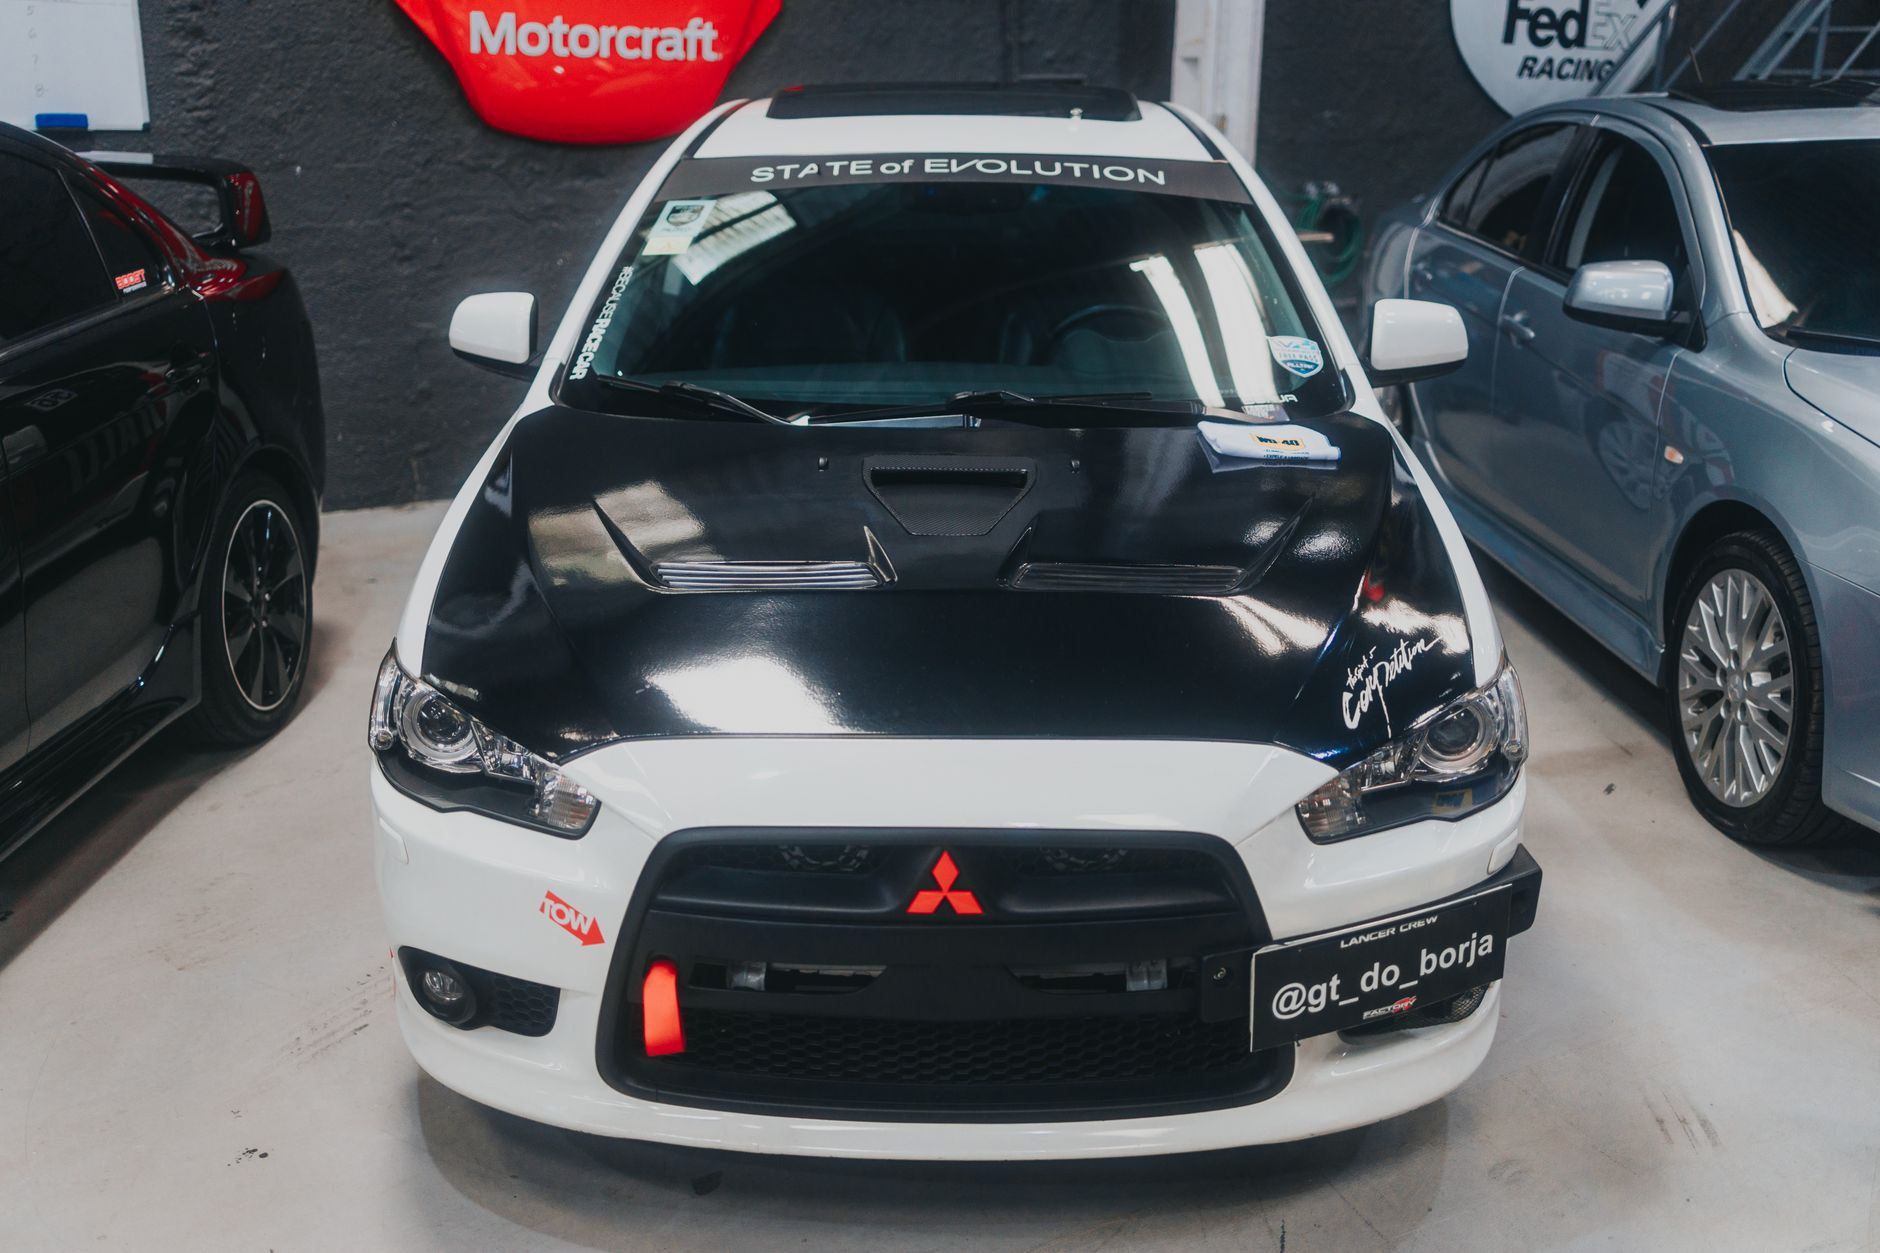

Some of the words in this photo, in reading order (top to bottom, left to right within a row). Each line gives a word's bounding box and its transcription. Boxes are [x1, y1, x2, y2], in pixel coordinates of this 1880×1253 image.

[469, 10, 721, 61] Motorcraft
[1517, 54, 1619, 82] RACING
[750, 160, 873, 183] STATE
[879, 159, 914, 174] of
[924, 158, 1166, 185] EVOLUTION
[544, 898, 590, 936] TOW
[1340, 926, 1396, 949] LANCER
[1400, 914, 1438, 932] CREW
[1272, 932, 1494, 1020] @gt_do_borja
[1362, 996, 1417, 1020] FACTORY
